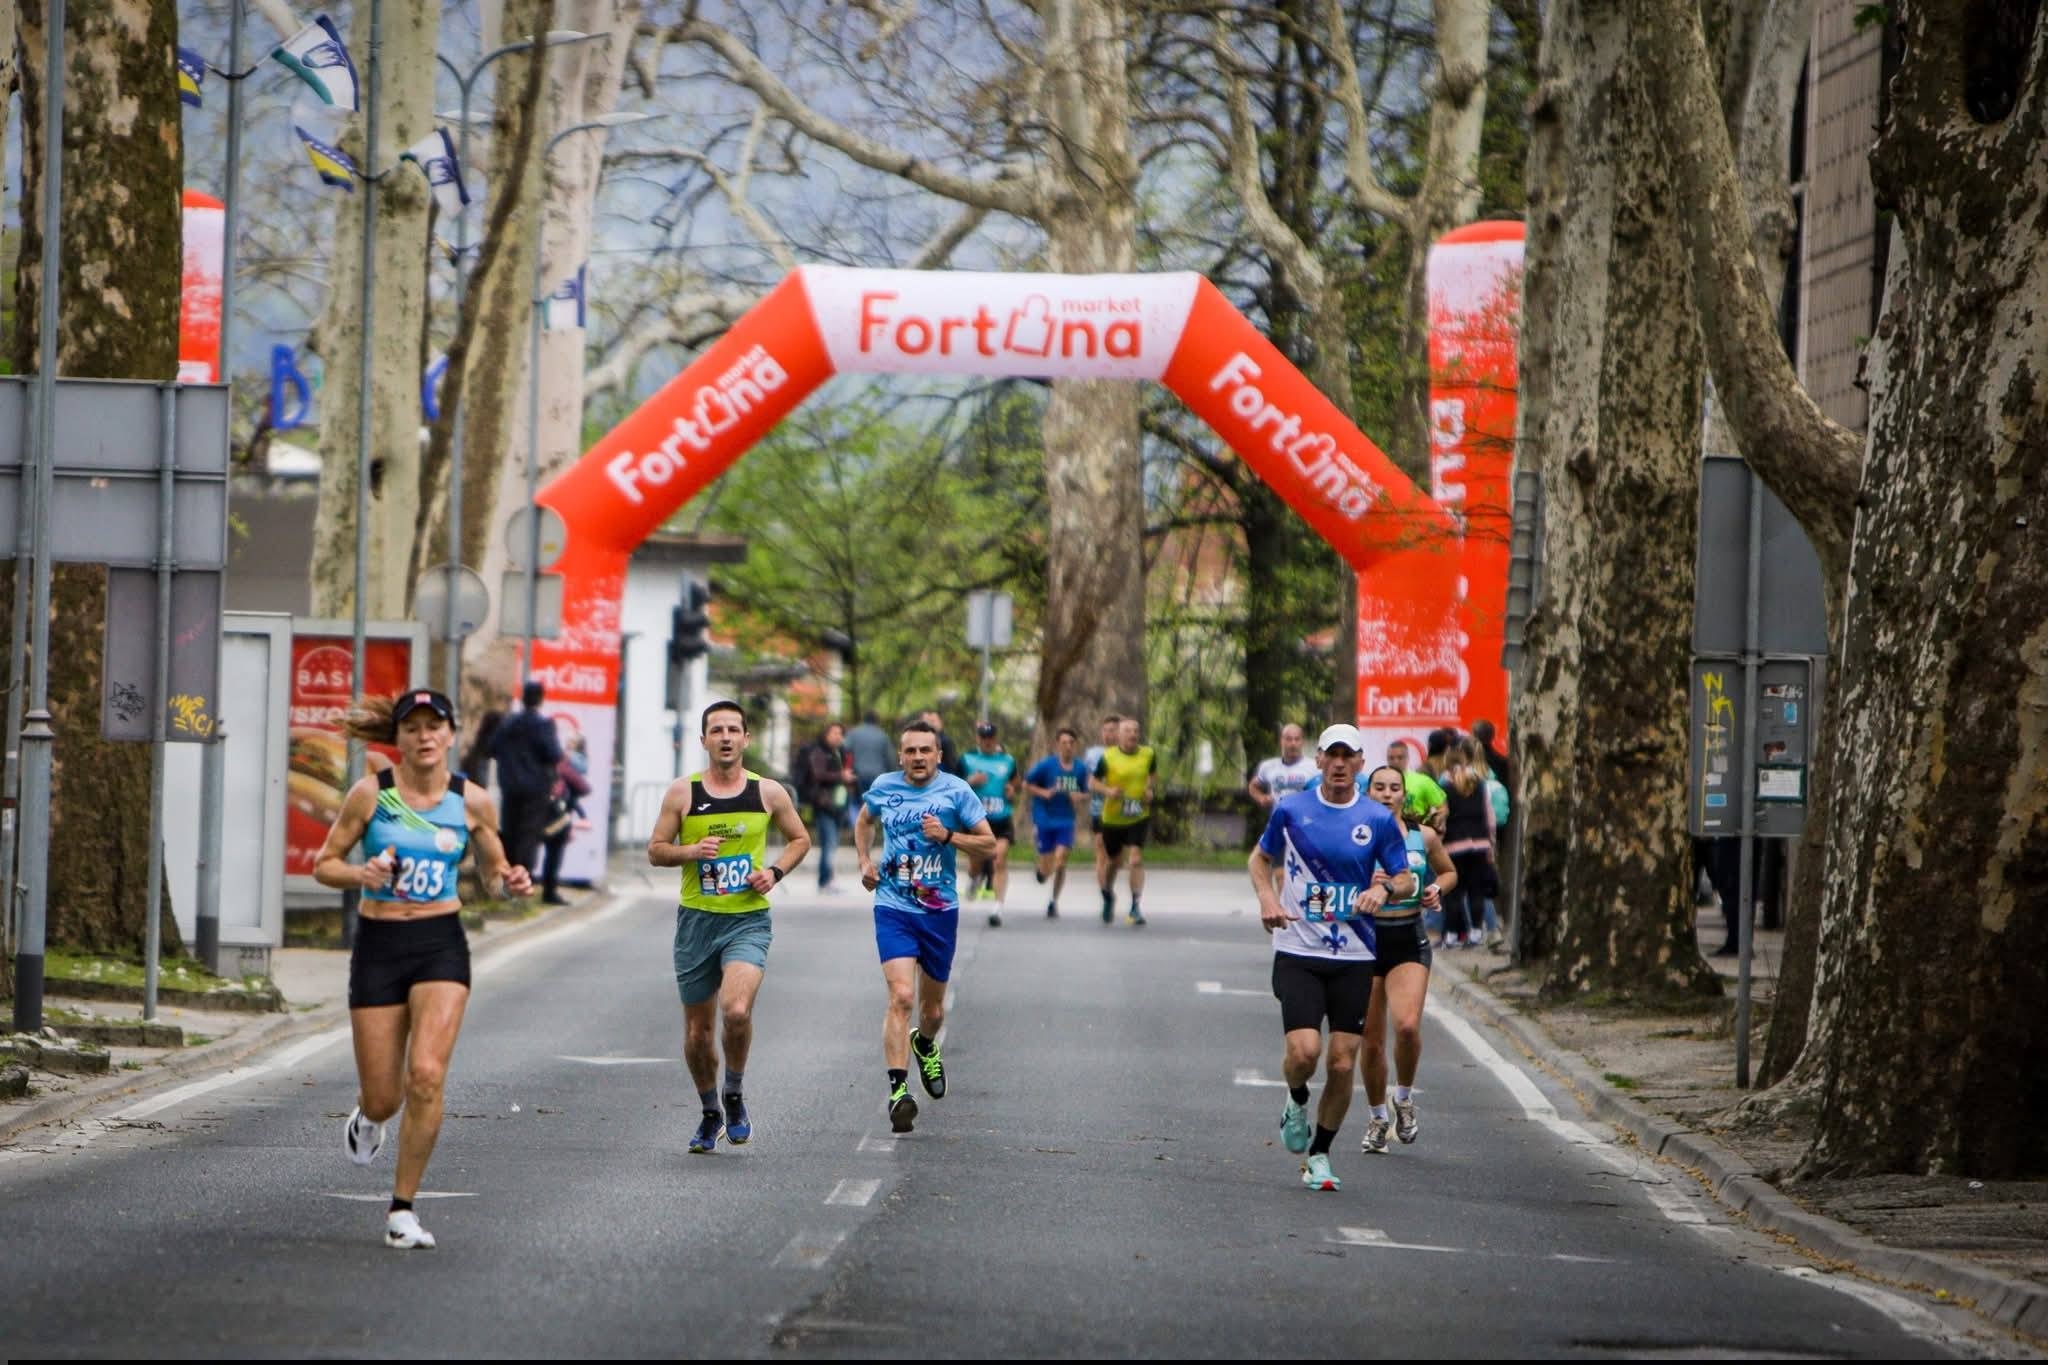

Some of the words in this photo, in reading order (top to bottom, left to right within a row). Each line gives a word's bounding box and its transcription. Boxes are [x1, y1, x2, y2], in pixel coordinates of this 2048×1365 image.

[1061, 296, 1142, 313] market
[398, 856, 446, 897] 263
[717, 858, 750, 889] 262
[912, 854, 943, 881] 244
[1325, 884, 1358, 912] 214
